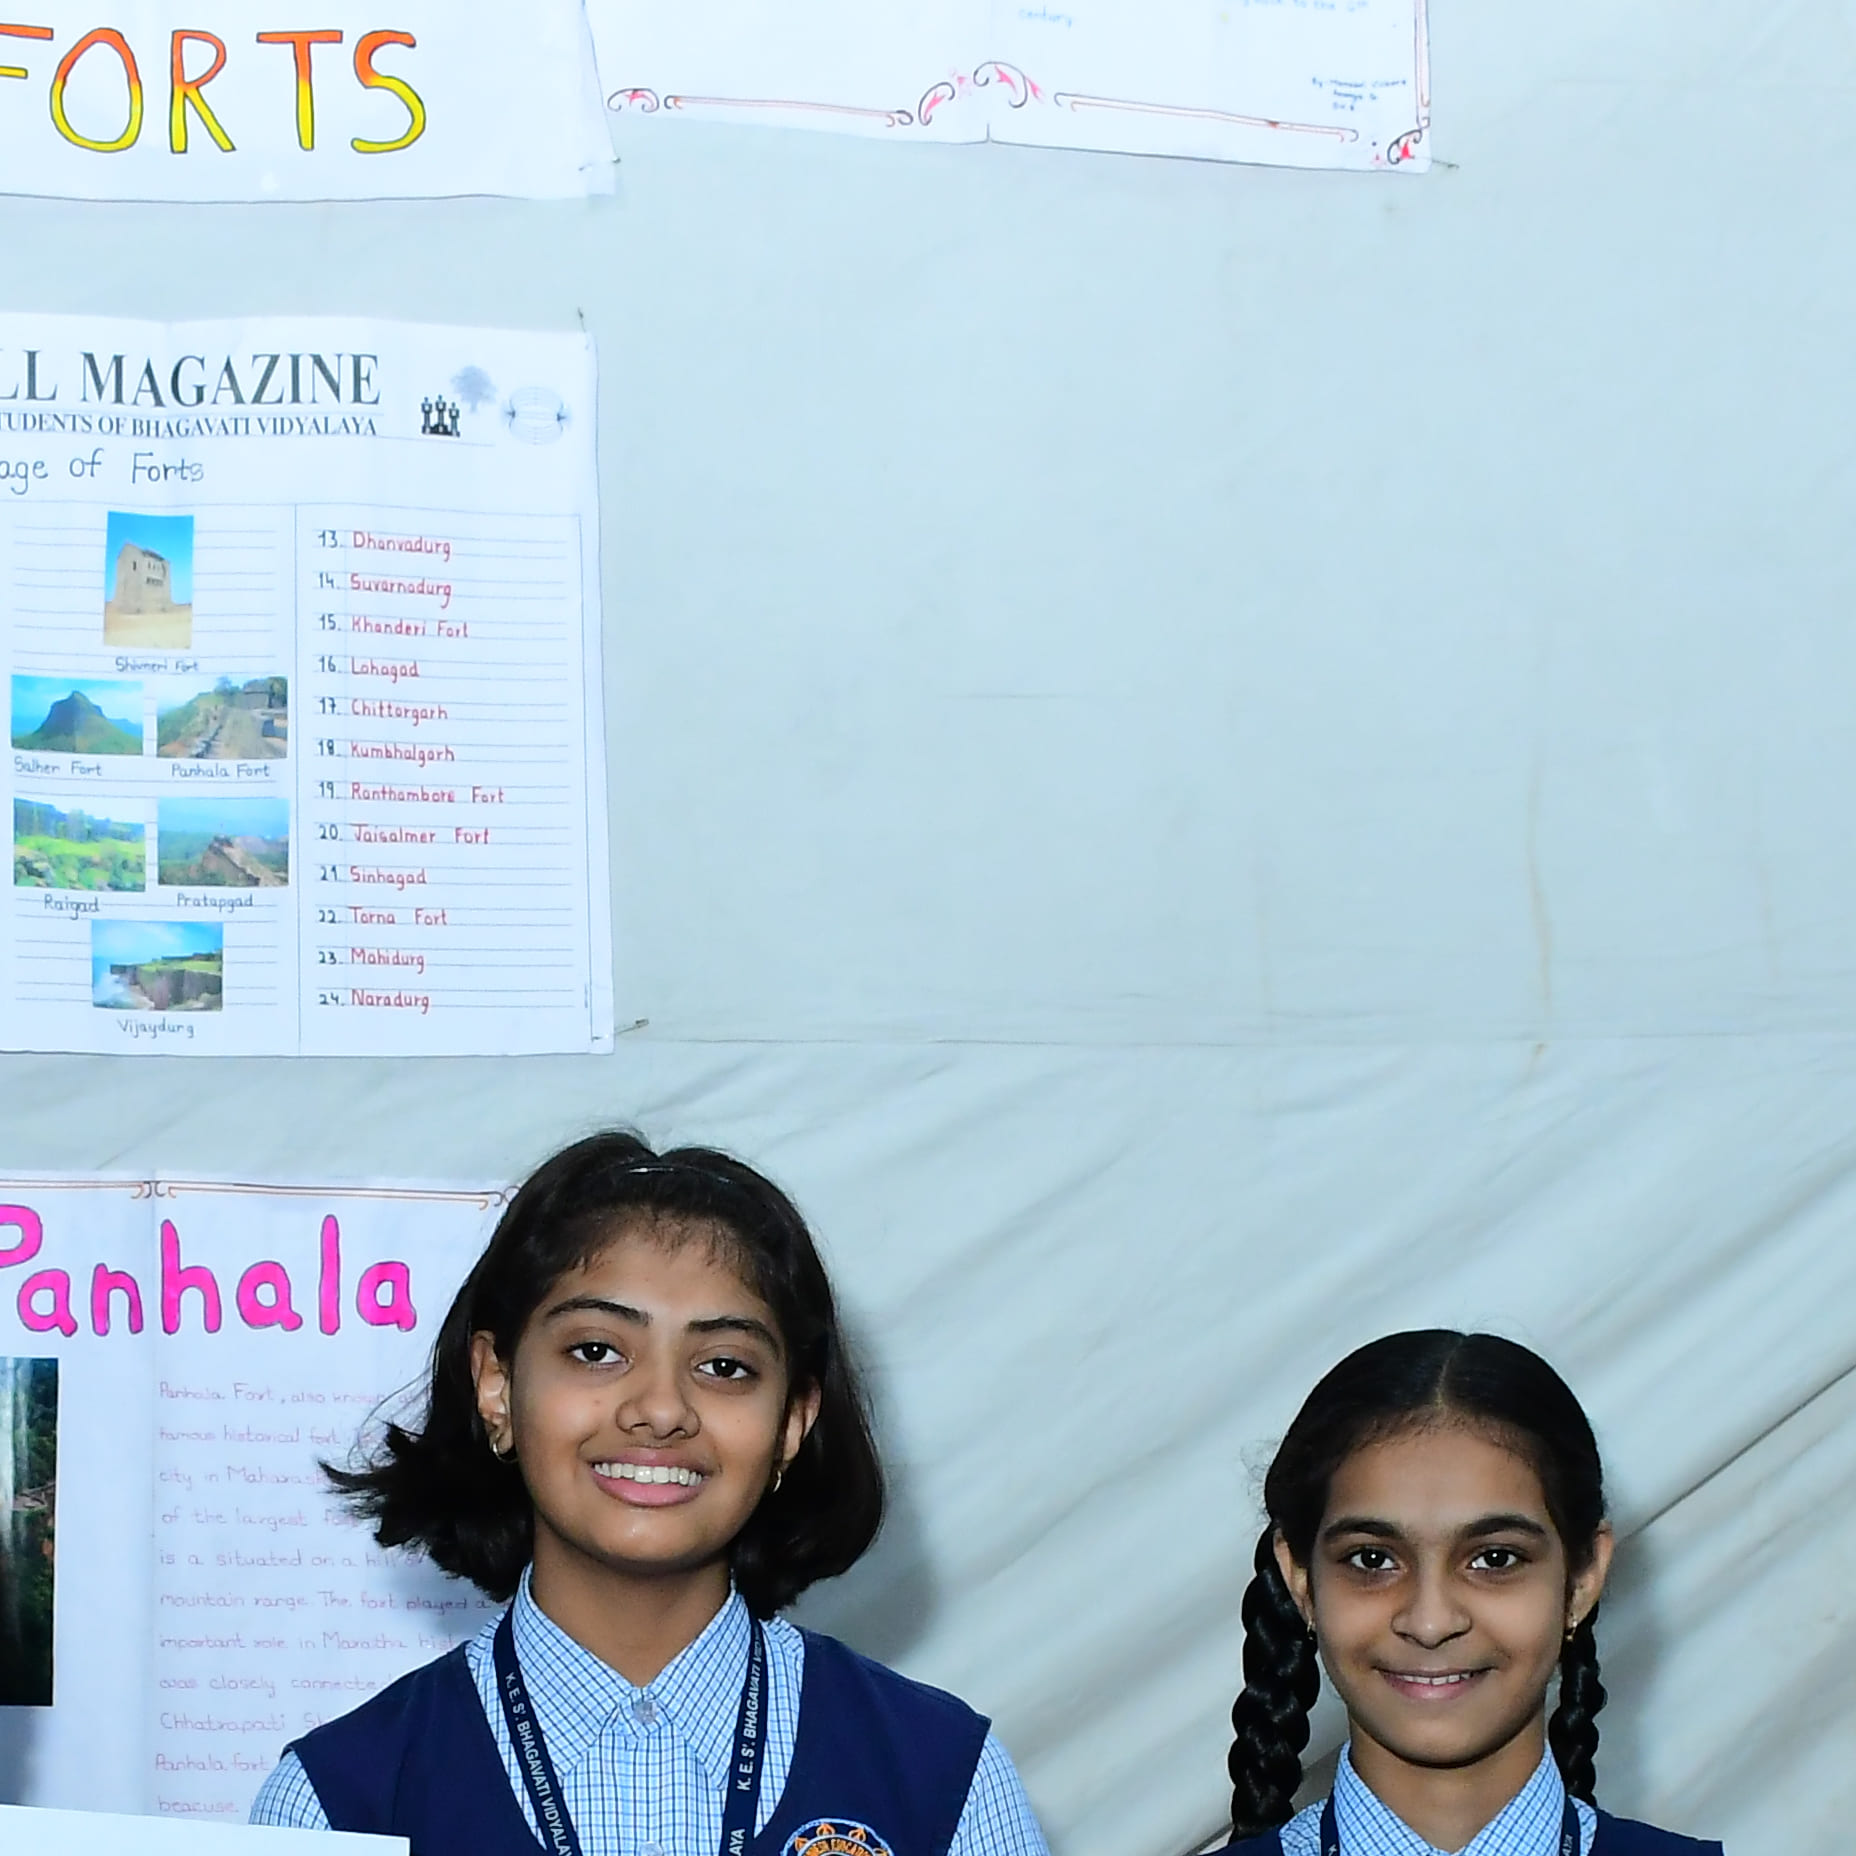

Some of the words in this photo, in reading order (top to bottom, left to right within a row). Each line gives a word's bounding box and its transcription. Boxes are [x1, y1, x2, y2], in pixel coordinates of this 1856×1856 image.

[80, 352, 380, 407] MAGAZINE
[99, 416, 127, 435] OF
[132, 417, 250, 438] BHAGAVATI
[257, 417, 377, 436] VIDYALAYA
[69, 448, 104, 477] of
[132, 452, 204, 484] Forts
[351, 574, 452, 609] Suvarnadurg
[352, 616, 426, 636] Khanderi
[437, 621, 468, 638] Fort
[115, 656, 168, 671] Shivneri
[176, 661, 198, 671] Fort
[351, 657, 420, 683] Lohagad
[352, 699, 448, 726] Chittorgarh
[351, 741, 455, 767] Kumbhalgarh
[14, 757, 60, 773] Salher
[71, 761, 102, 776] Fort
[172, 764, 229, 777] Panhala
[236, 764, 270, 777] Fort
[472, 786, 504, 803] Fort
[348, 824, 436, 843] Jaisalmer
[455, 828, 490, 844] Fort
[350, 867, 428, 891] Sinhagad
[44, 894, 100, 920] Raigad
[177, 893, 254, 912] Pratapgad
[348, 907, 396, 924] Torna
[415, 909, 447, 926] Fort
[351, 948, 425, 974] Mahidurg
[351, 989, 430, 1014] Naradurg
[117, 1019, 194, 1038] Vijaydurg
[160, 1550, 175, 1565] is
[217, 1550, 301, 1566] situated
